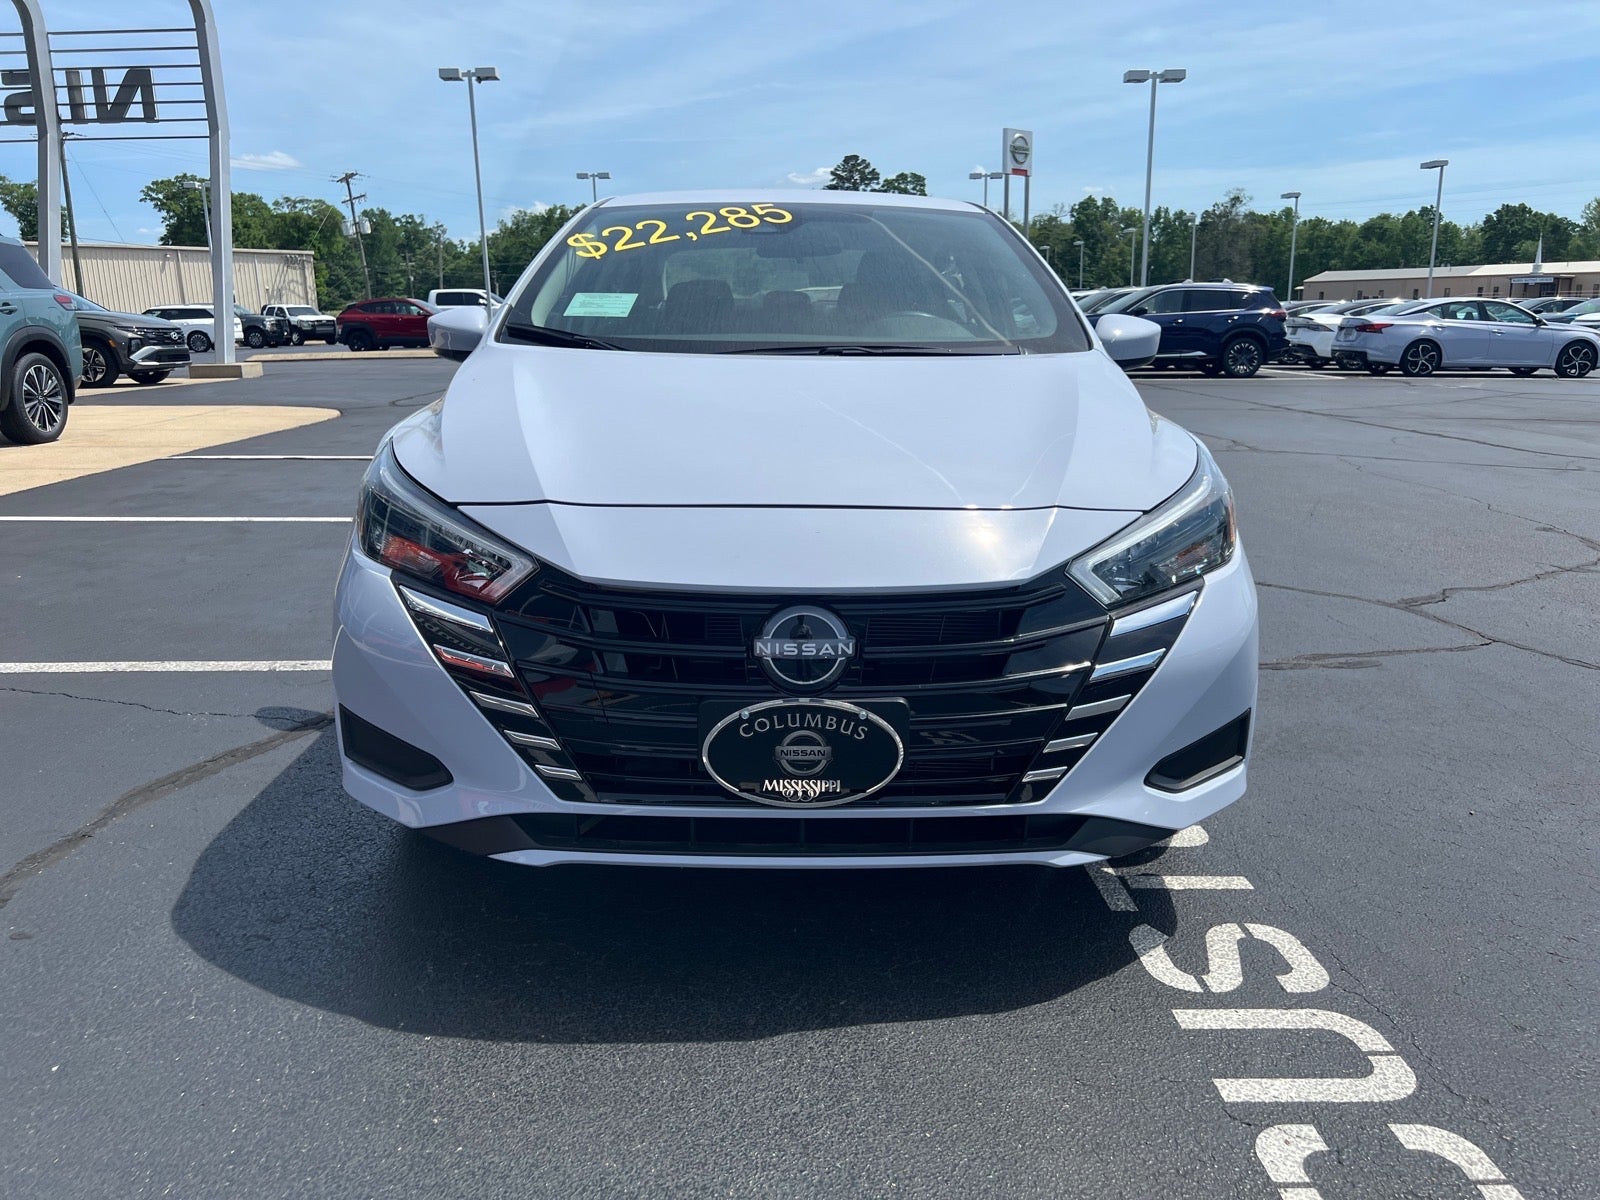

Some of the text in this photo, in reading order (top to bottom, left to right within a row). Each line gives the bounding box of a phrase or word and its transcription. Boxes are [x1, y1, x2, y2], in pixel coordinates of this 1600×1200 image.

[566, 203, 793, 260] $22,285
[756, 641, 853, 656] NISSAN
[740, 714, 868, 740] COLUMBUS
[780, 749, 826, 757] NISSAN
[762, 779, 841, 802] MISSISSIPPI
